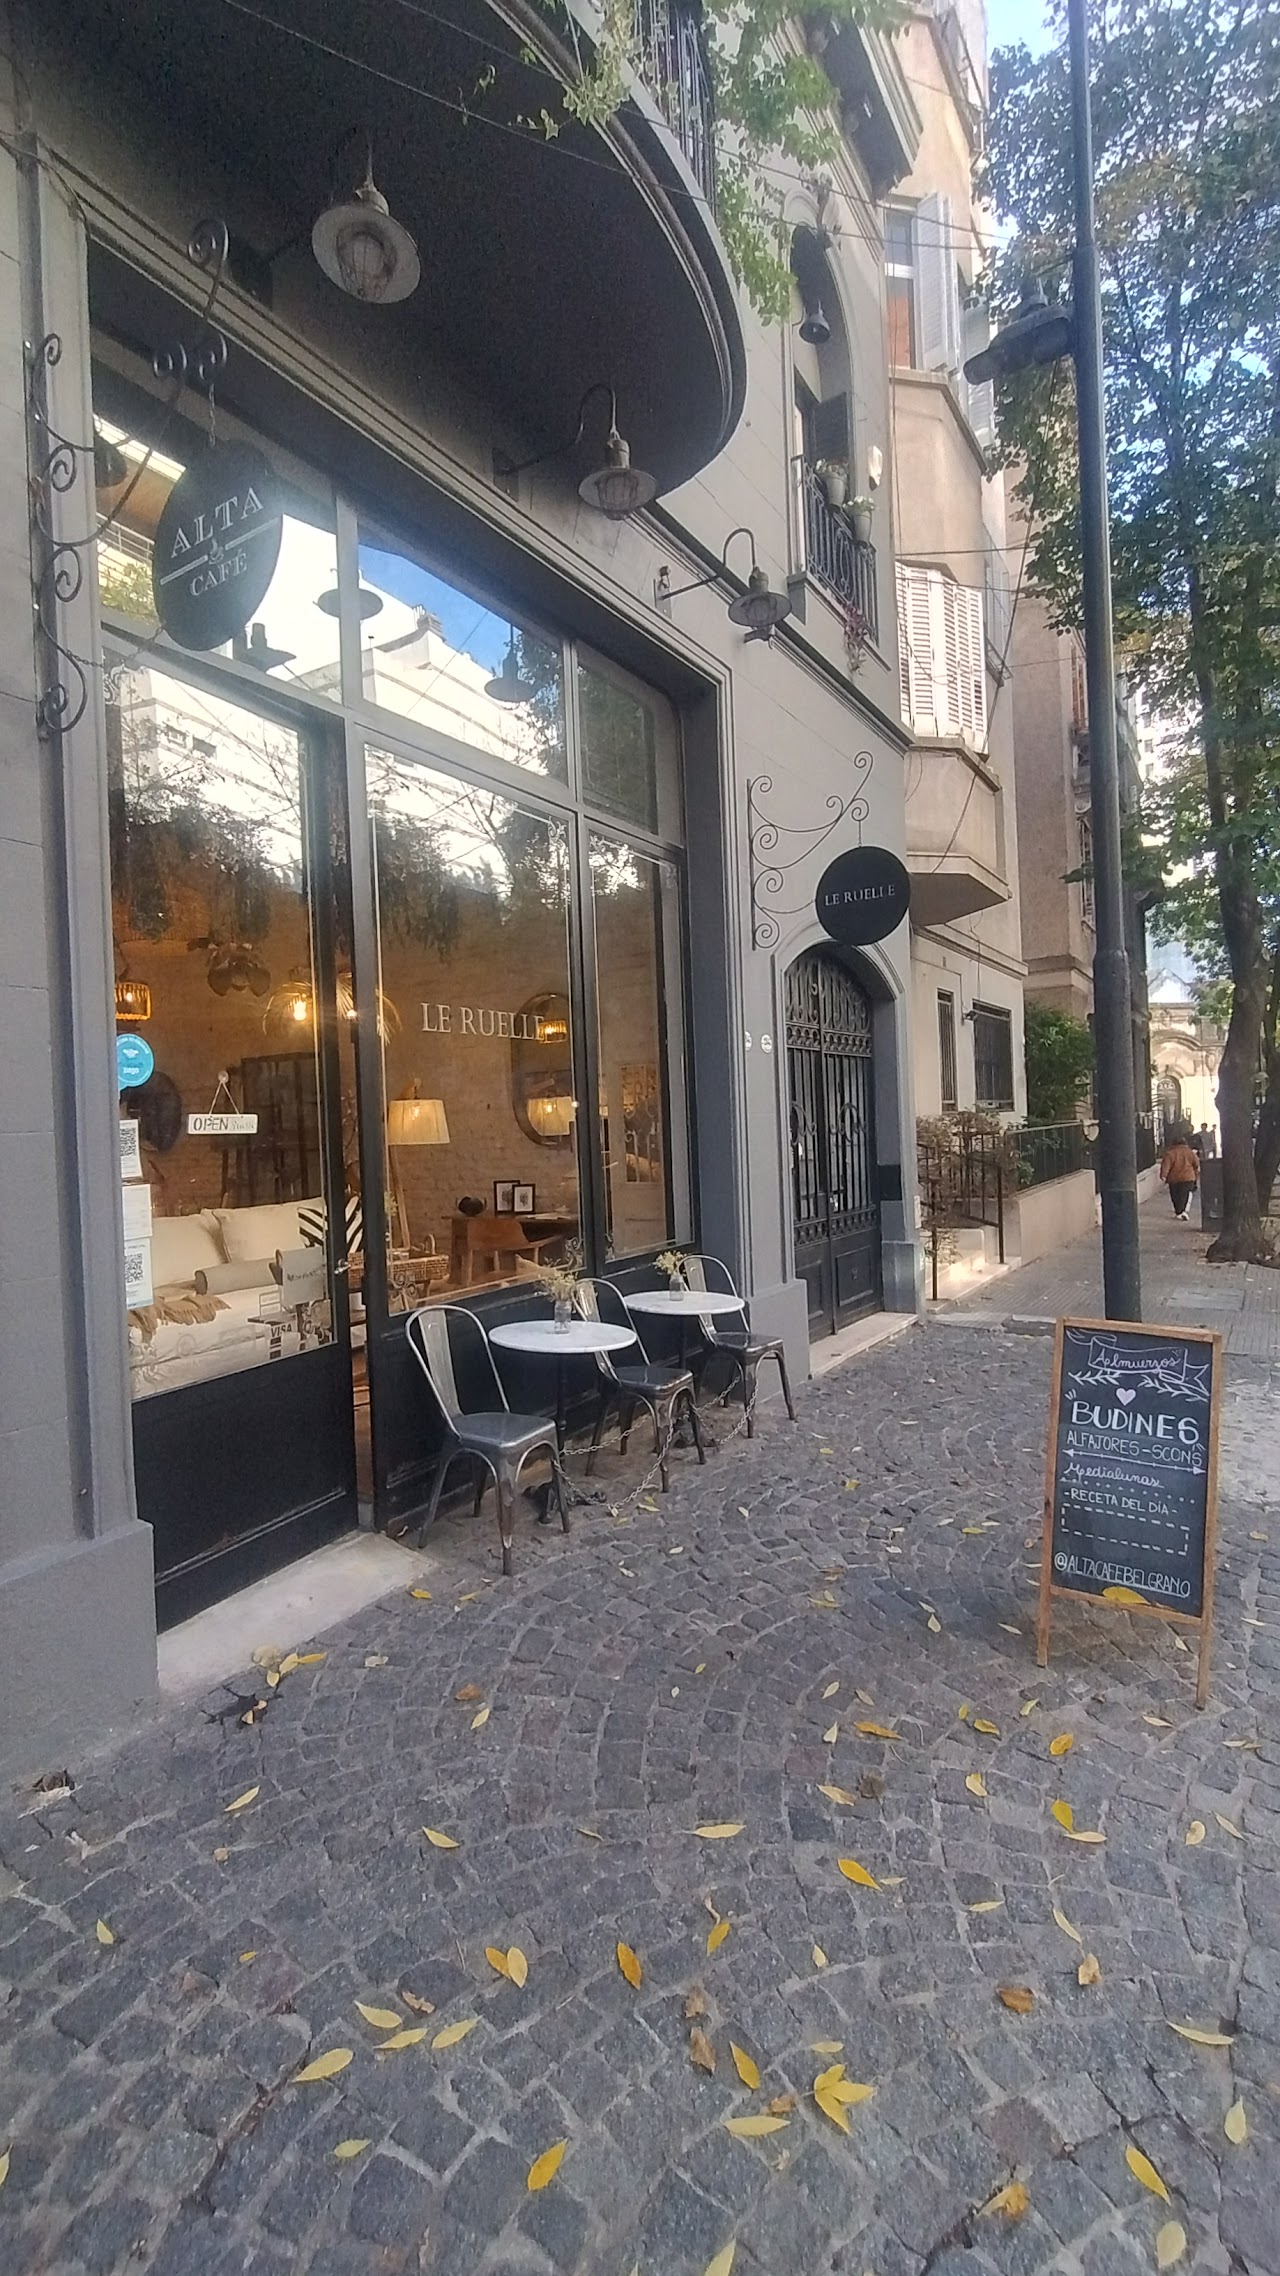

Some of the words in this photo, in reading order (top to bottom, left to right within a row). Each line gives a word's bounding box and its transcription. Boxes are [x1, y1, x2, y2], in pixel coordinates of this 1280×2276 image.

[170, 487, 264, 559] ALTA
[189, 548, 248, 596] CAFÉ
[824, 893, 840, 906] LE
[843, 884, 896, 903] RUELLE
[420, 1002, 452, 1033] LE
[459, 1006, 546, 1042] RUELLE
[193, 1116, 229, 1131] OPEN
[270, 1323, 292, 1338] VISA
[1071, 1400, 1200, 1445] BUDINES
[1121, 1497, 1146, 1512] DEL
[1054, 1551, 1191, 1598] @ALTACAFEBELGRANO
